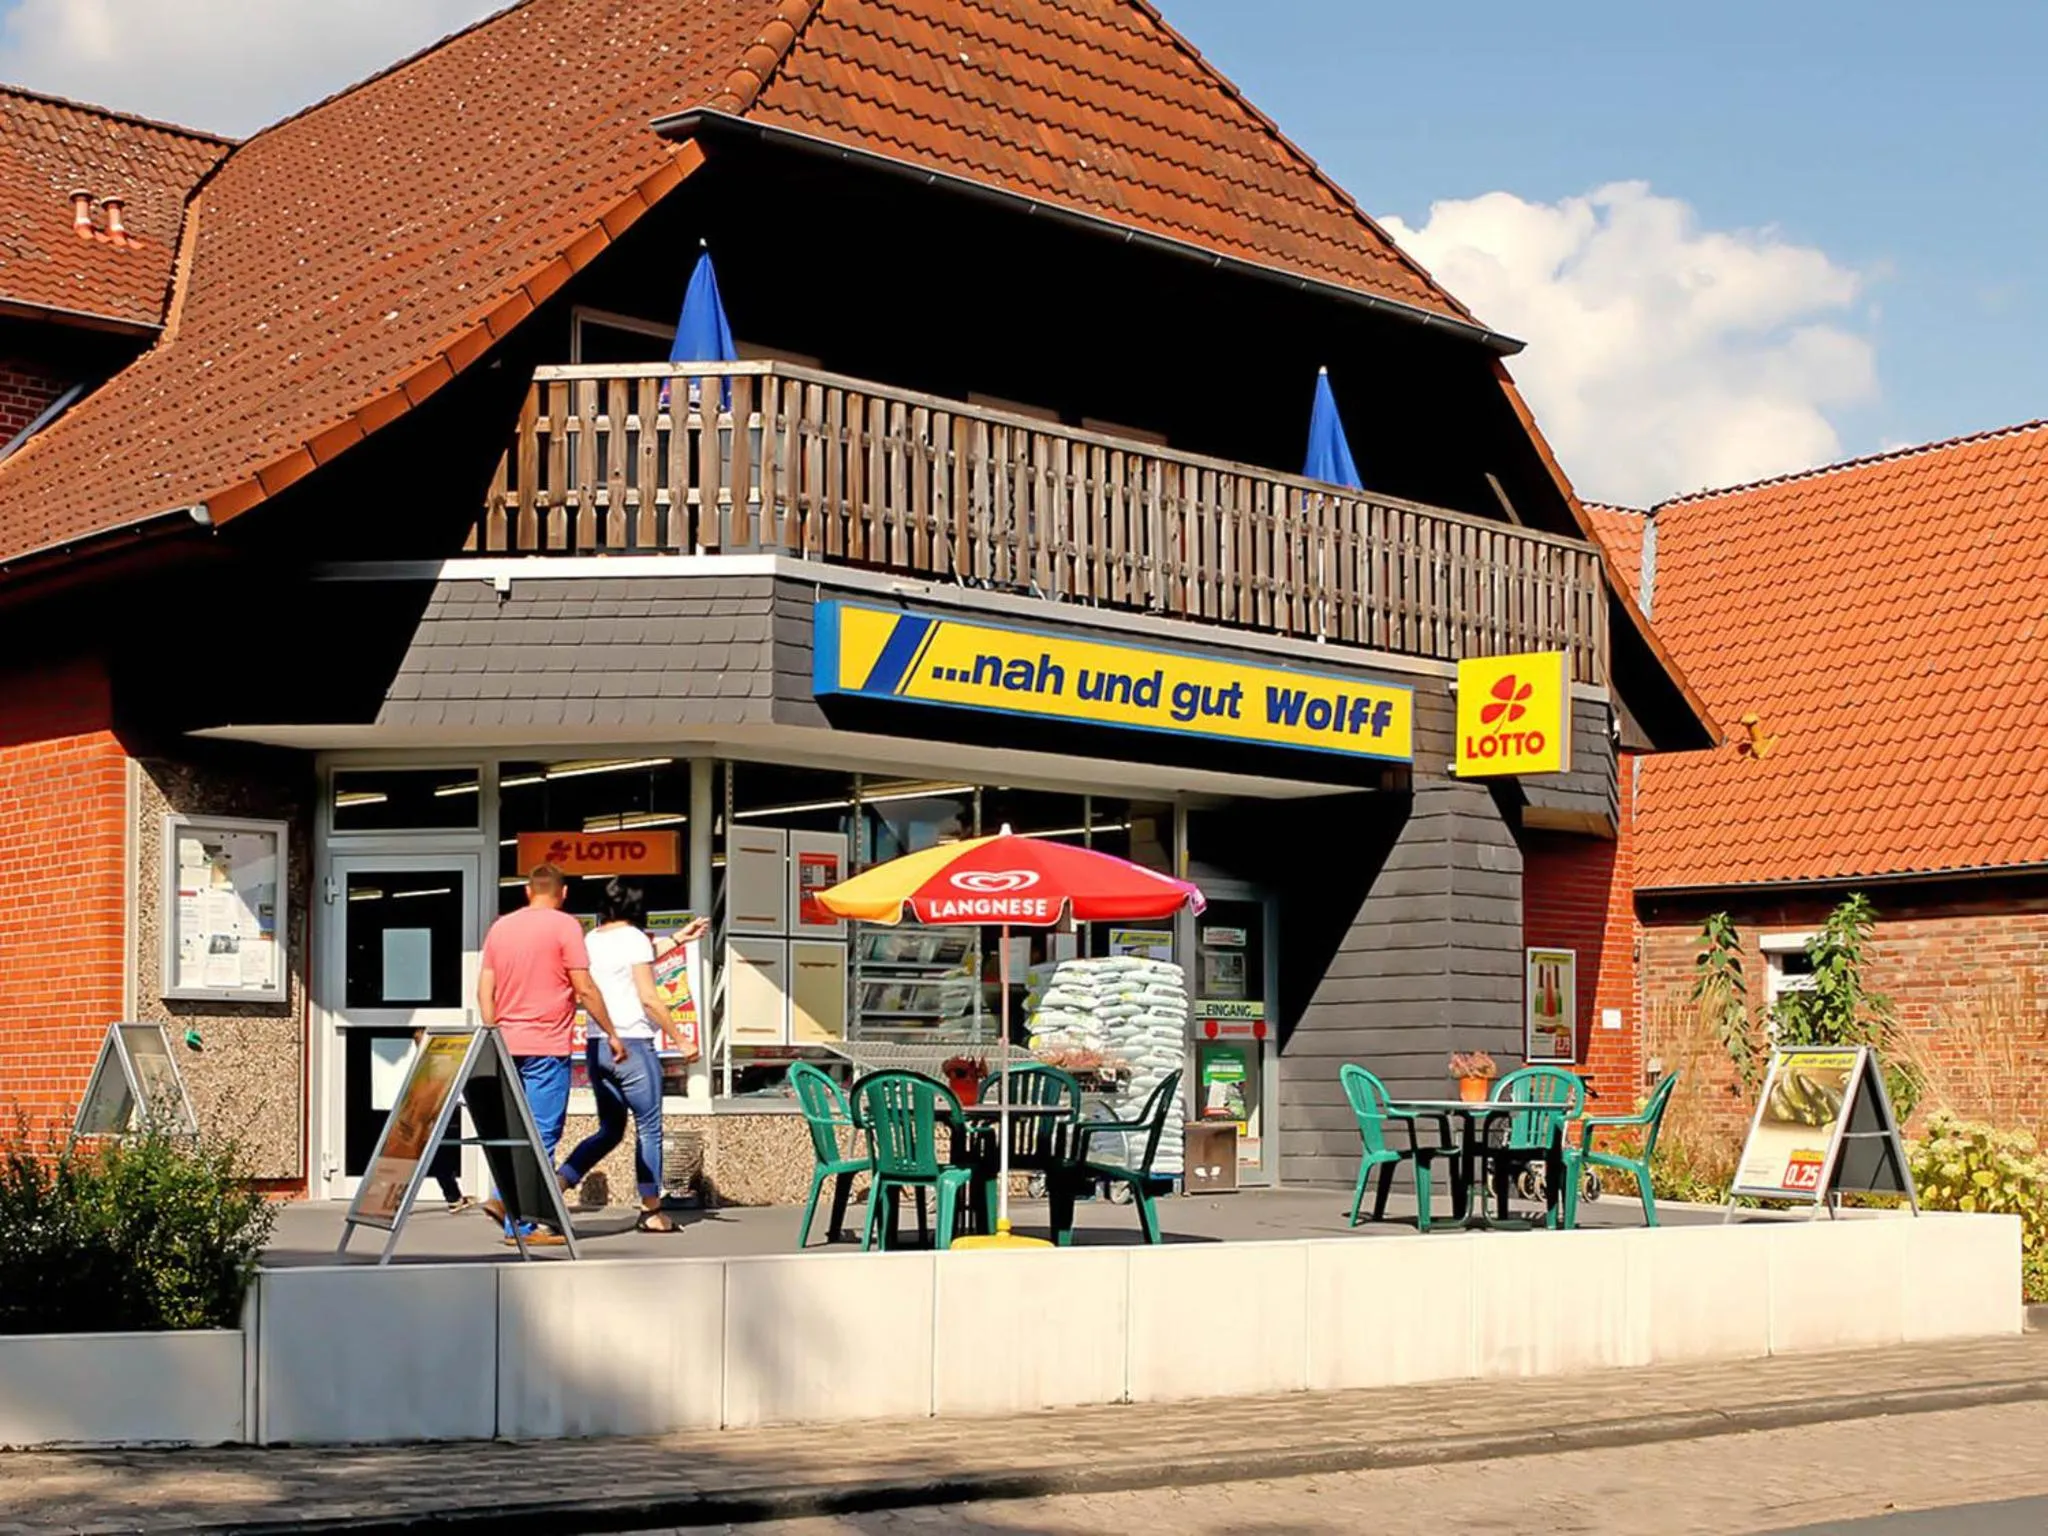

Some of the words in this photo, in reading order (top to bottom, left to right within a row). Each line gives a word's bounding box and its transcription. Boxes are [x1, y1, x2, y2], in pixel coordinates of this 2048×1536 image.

[932, 653, 1065, 695] ...nah
[1077, 669, 1164, 708] und
[1170, 681, 1244, 722] gut
[1265, 685, 1394, 738] Wolff
[1466, 730, 1545, 759] LOTTO
[575, 840, 647, 861] LOTTO
[929, 898, 1049, 919] LANGNESE
[1206, 1003, 1253, 1017] EINGANG
[1785, 1164, 1822, 1186] 0.25
